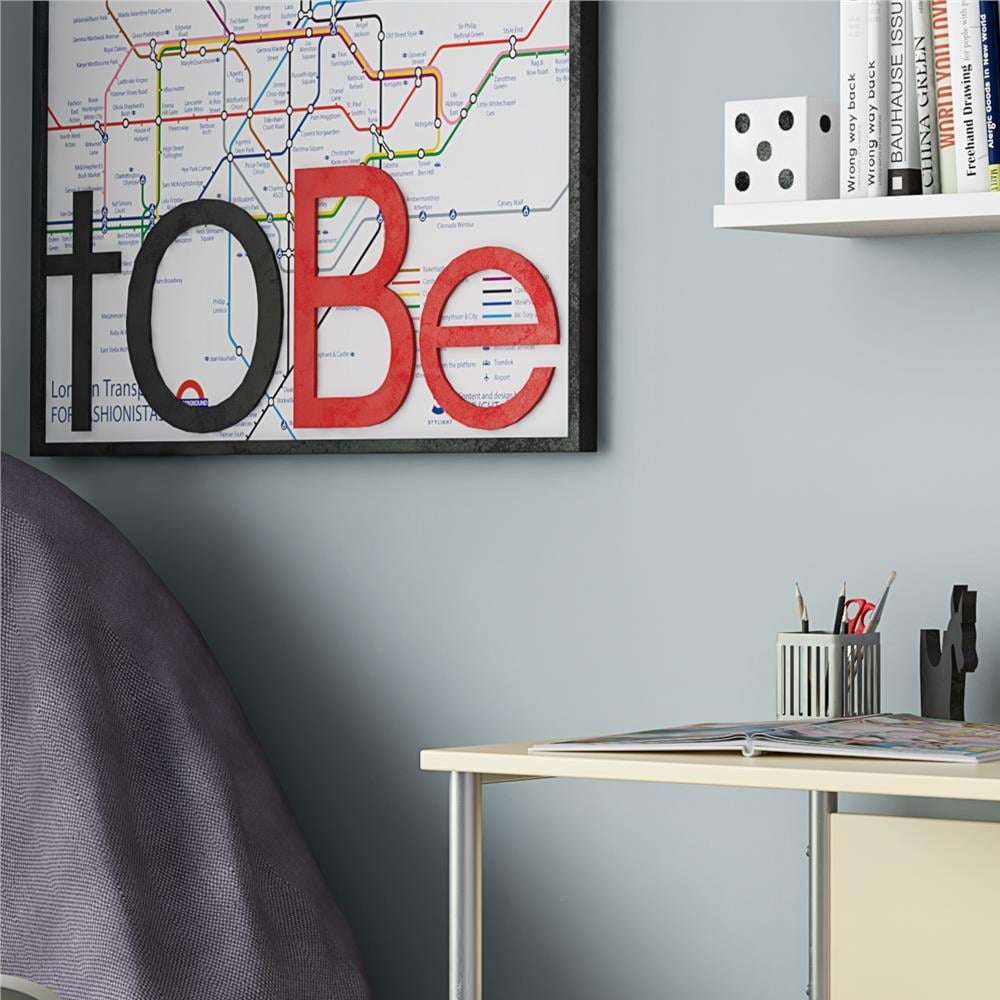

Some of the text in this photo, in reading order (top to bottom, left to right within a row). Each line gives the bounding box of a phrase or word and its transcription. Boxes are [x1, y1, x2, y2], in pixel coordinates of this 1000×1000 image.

[868, 60, 878, 186] Wrong way back
[891, 54, 903, 163] BAUHAUSE
[914, 36, 934, 188] CHINA GREEN
[961, 64, 973, 116] Drawing
[847, 73, 858, 192] Wrong way back
[965, 119, 977, 177] Freehand
[51, 379, 99, 398] Lonn
[481, 391, 493, 399] and
[493, 391, 513, 401] design
